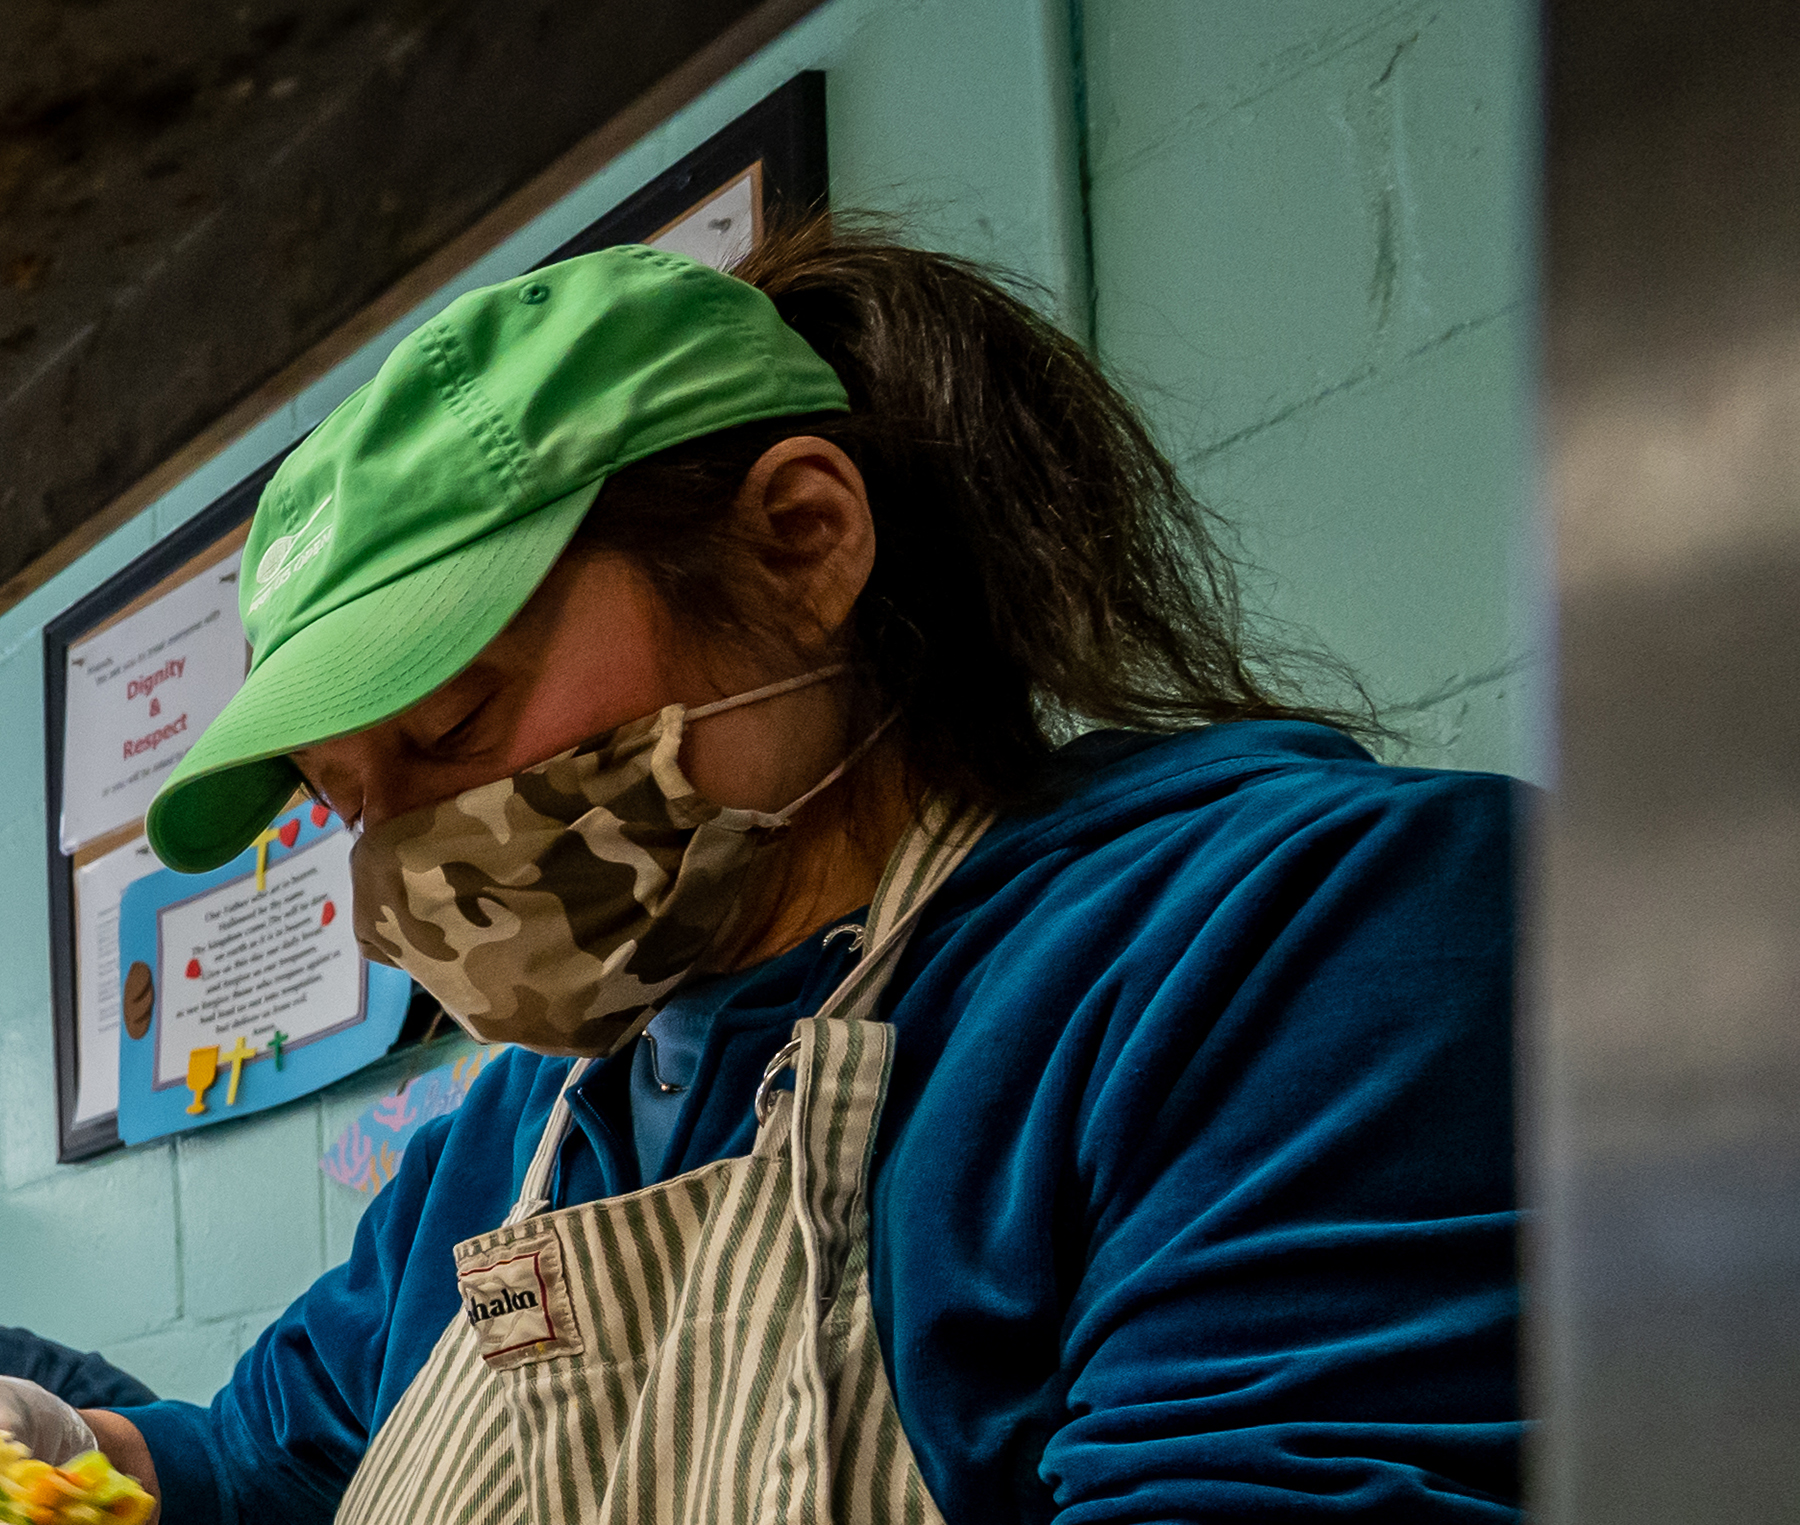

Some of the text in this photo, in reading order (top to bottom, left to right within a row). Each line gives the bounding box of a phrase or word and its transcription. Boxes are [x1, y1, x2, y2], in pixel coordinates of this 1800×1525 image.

[293, 528, 333, 572] OPEN
[127, 657, 186, 700] Dignity
[149, 697, 161, 718] &
[123, 714, 187, 761] Respect
